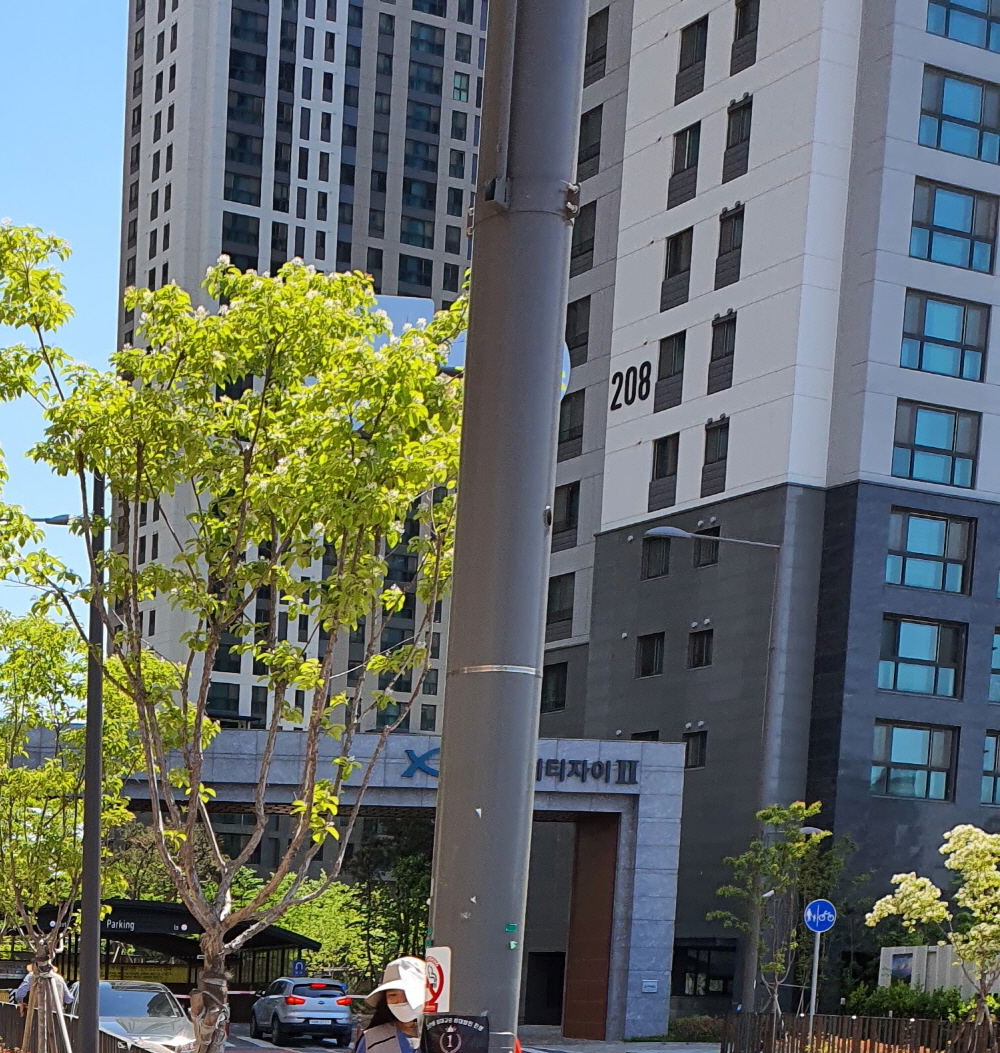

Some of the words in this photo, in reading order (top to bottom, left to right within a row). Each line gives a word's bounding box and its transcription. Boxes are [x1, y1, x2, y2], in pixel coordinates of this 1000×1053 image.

[610, 360, 652, 411] 208
[106, 919, 135, 931] Parking
[446, 1034, 453, 1048] 1
